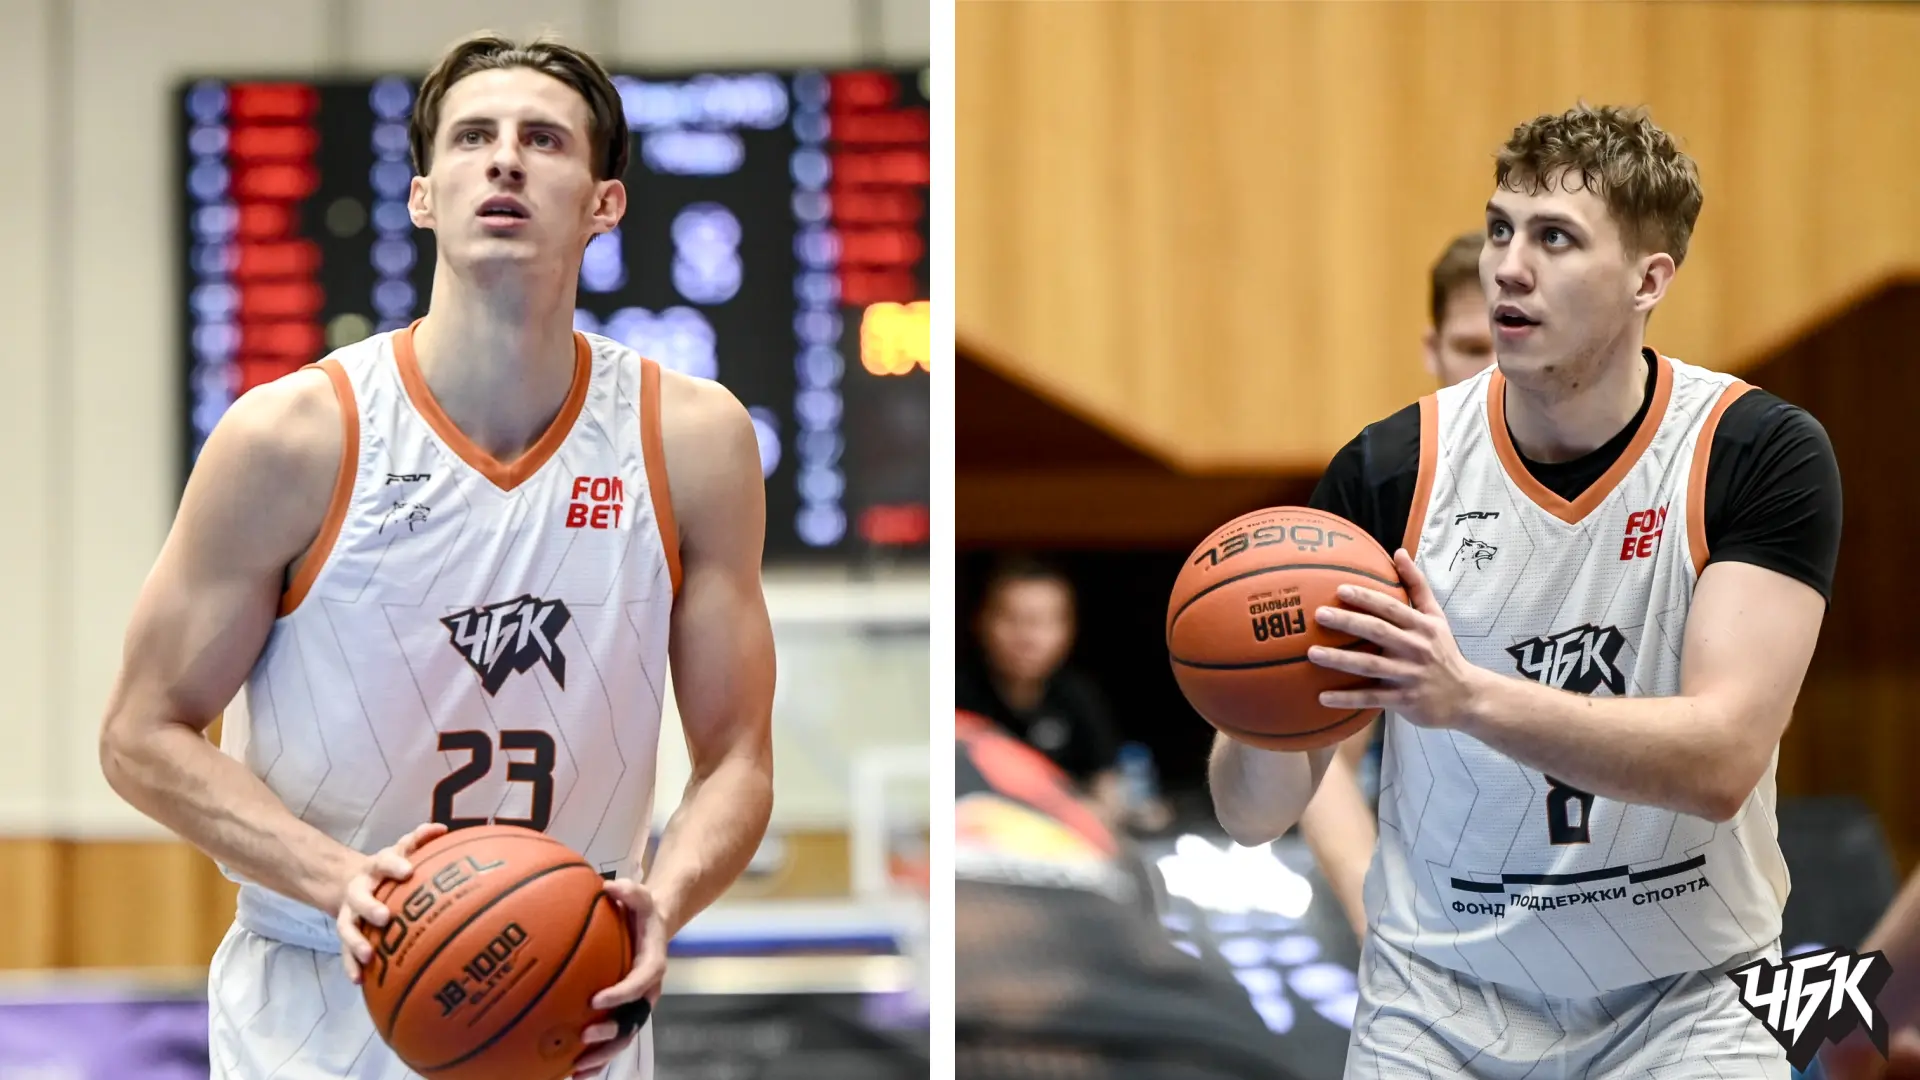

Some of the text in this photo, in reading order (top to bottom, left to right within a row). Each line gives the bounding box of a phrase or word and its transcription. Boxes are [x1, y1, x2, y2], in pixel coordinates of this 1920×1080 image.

[571, 476, 623, 502] FON
[565, 503, 623, 529] BET
[1249, 595, 1301, 615] APPROVED
[1252, 608, 1306, 642] FIBA
[431, 728, 556, 833] 23
[1452, 877, 1710, 918] ФОНД ПОДДЕРЖКИ СПОРТА
[434, 922, 527, 1018] JB-1000
